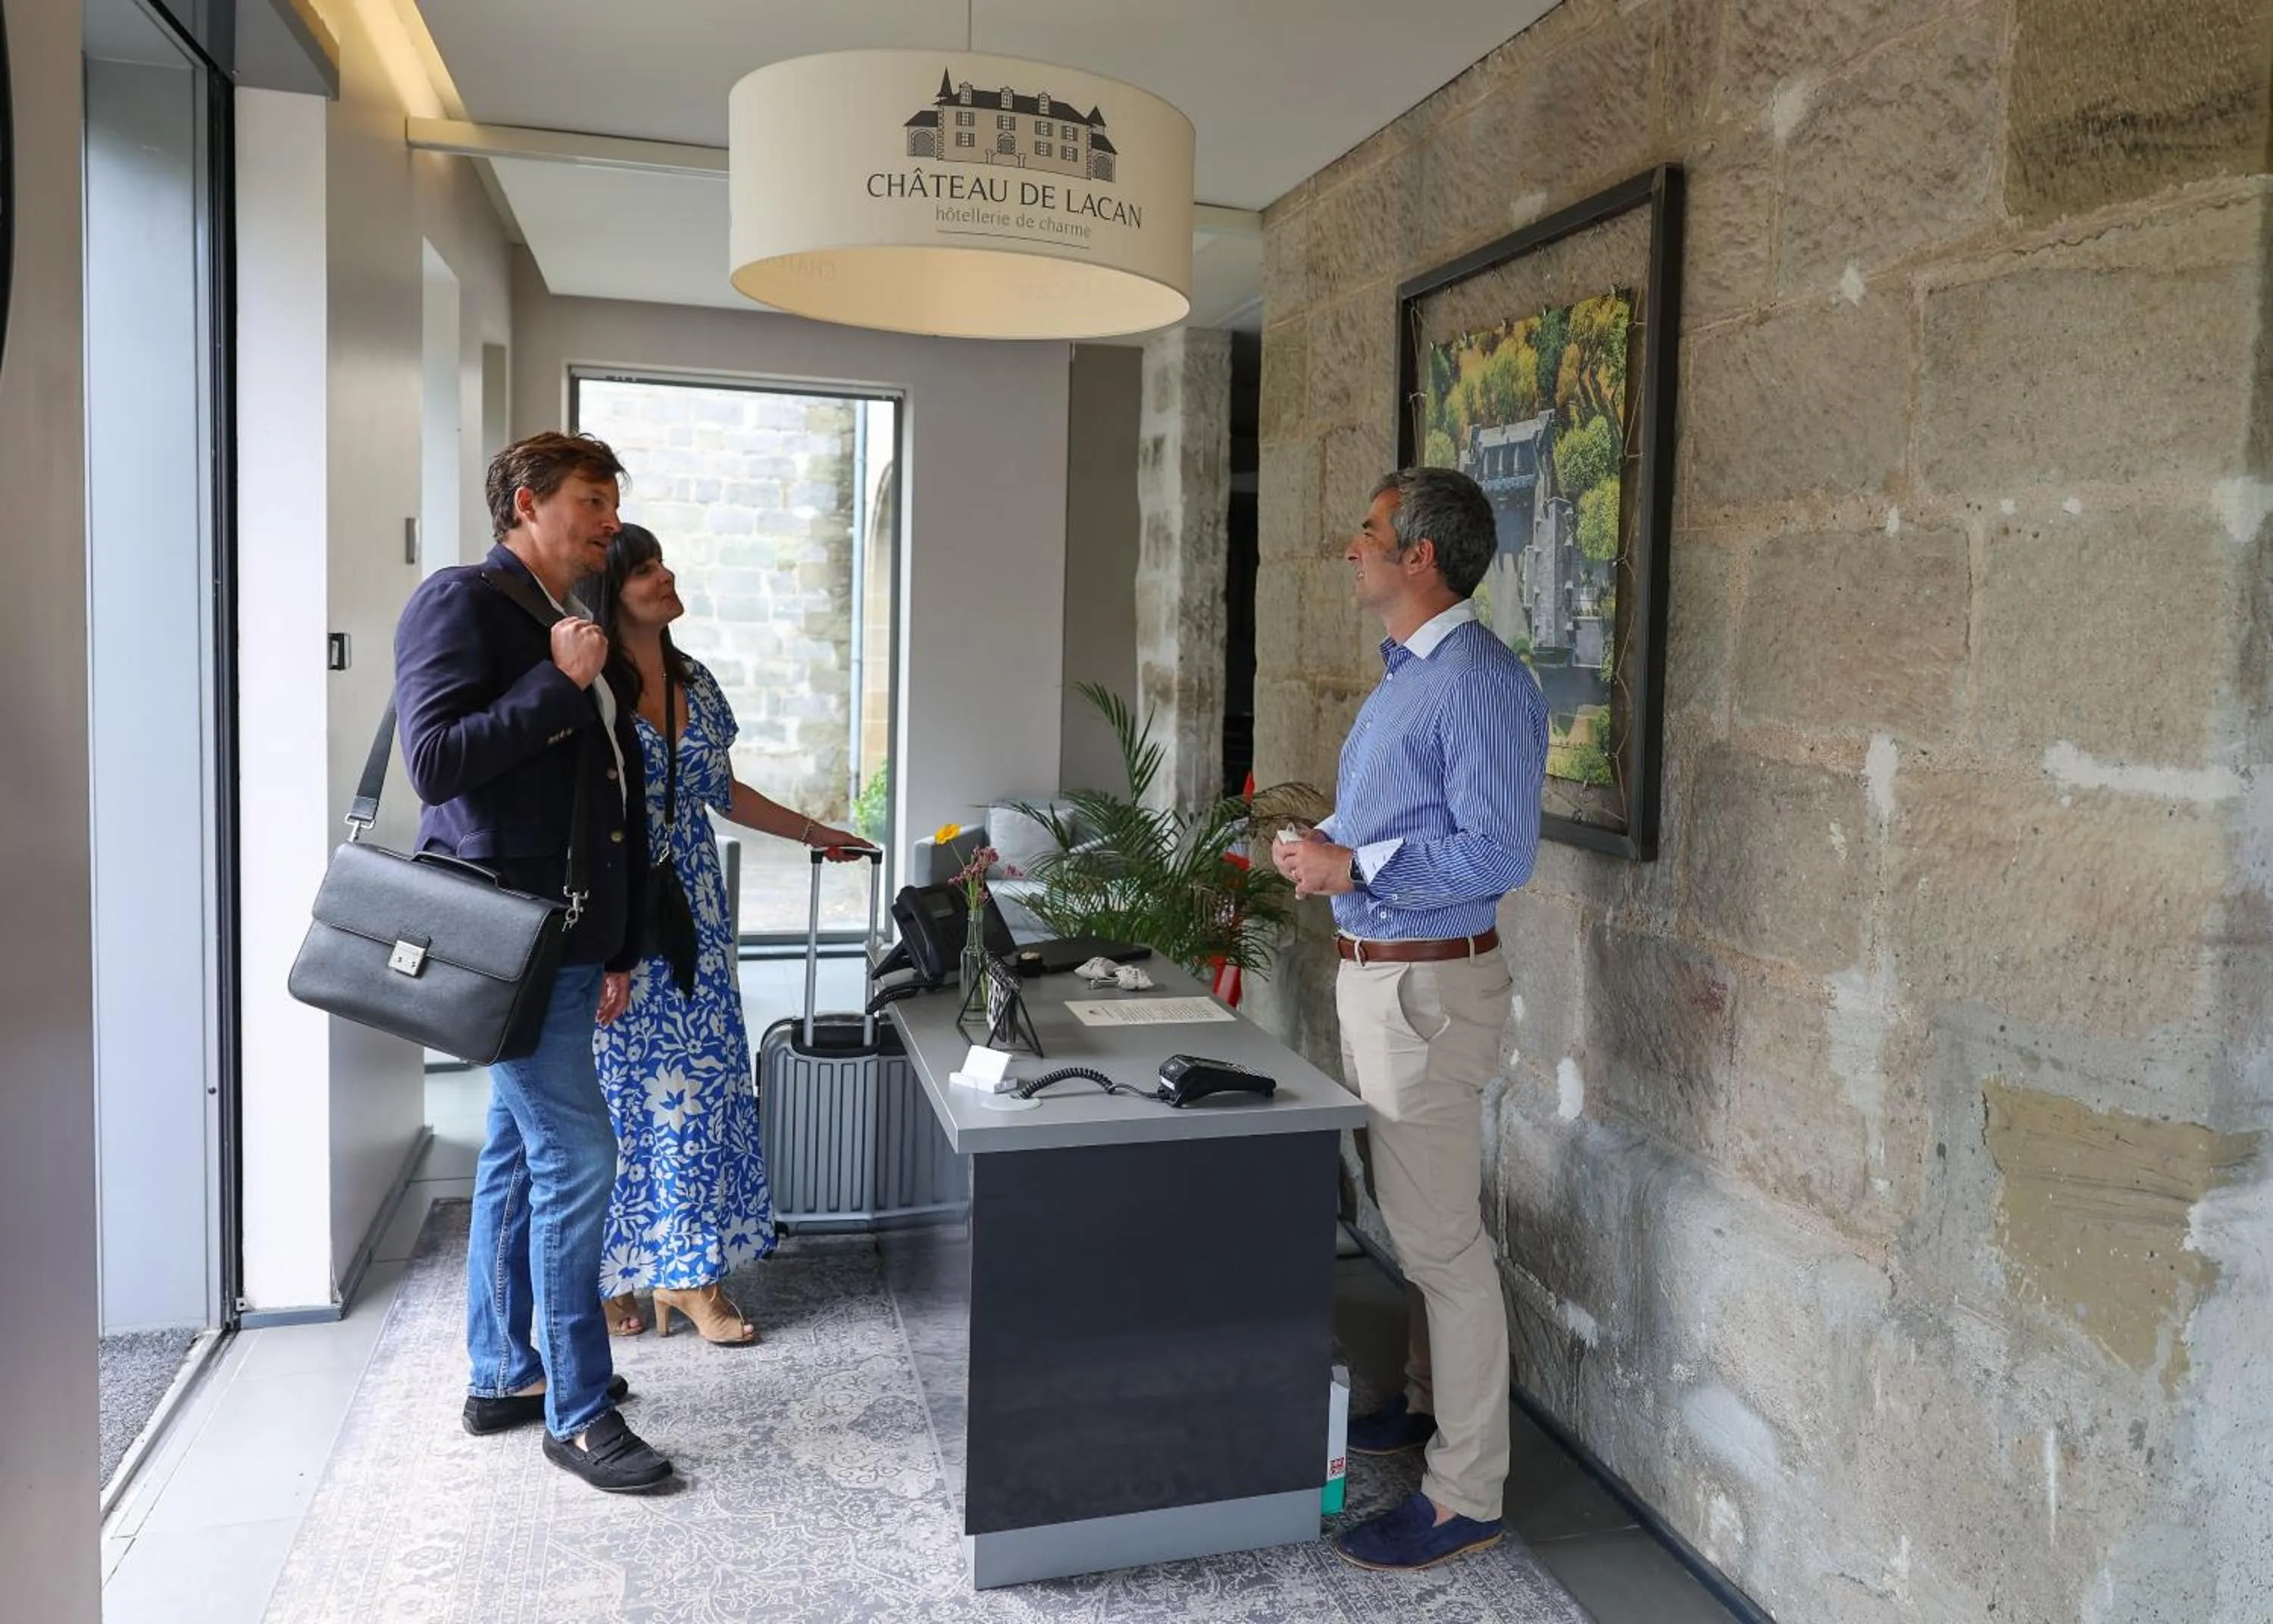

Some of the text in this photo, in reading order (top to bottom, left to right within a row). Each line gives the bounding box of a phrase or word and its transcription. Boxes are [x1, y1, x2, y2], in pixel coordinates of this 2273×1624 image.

[867, 167, 1142, 229] CHÂTEAU DE LACAN
[935, 205, 1092, 239] hôtellerie de charme
